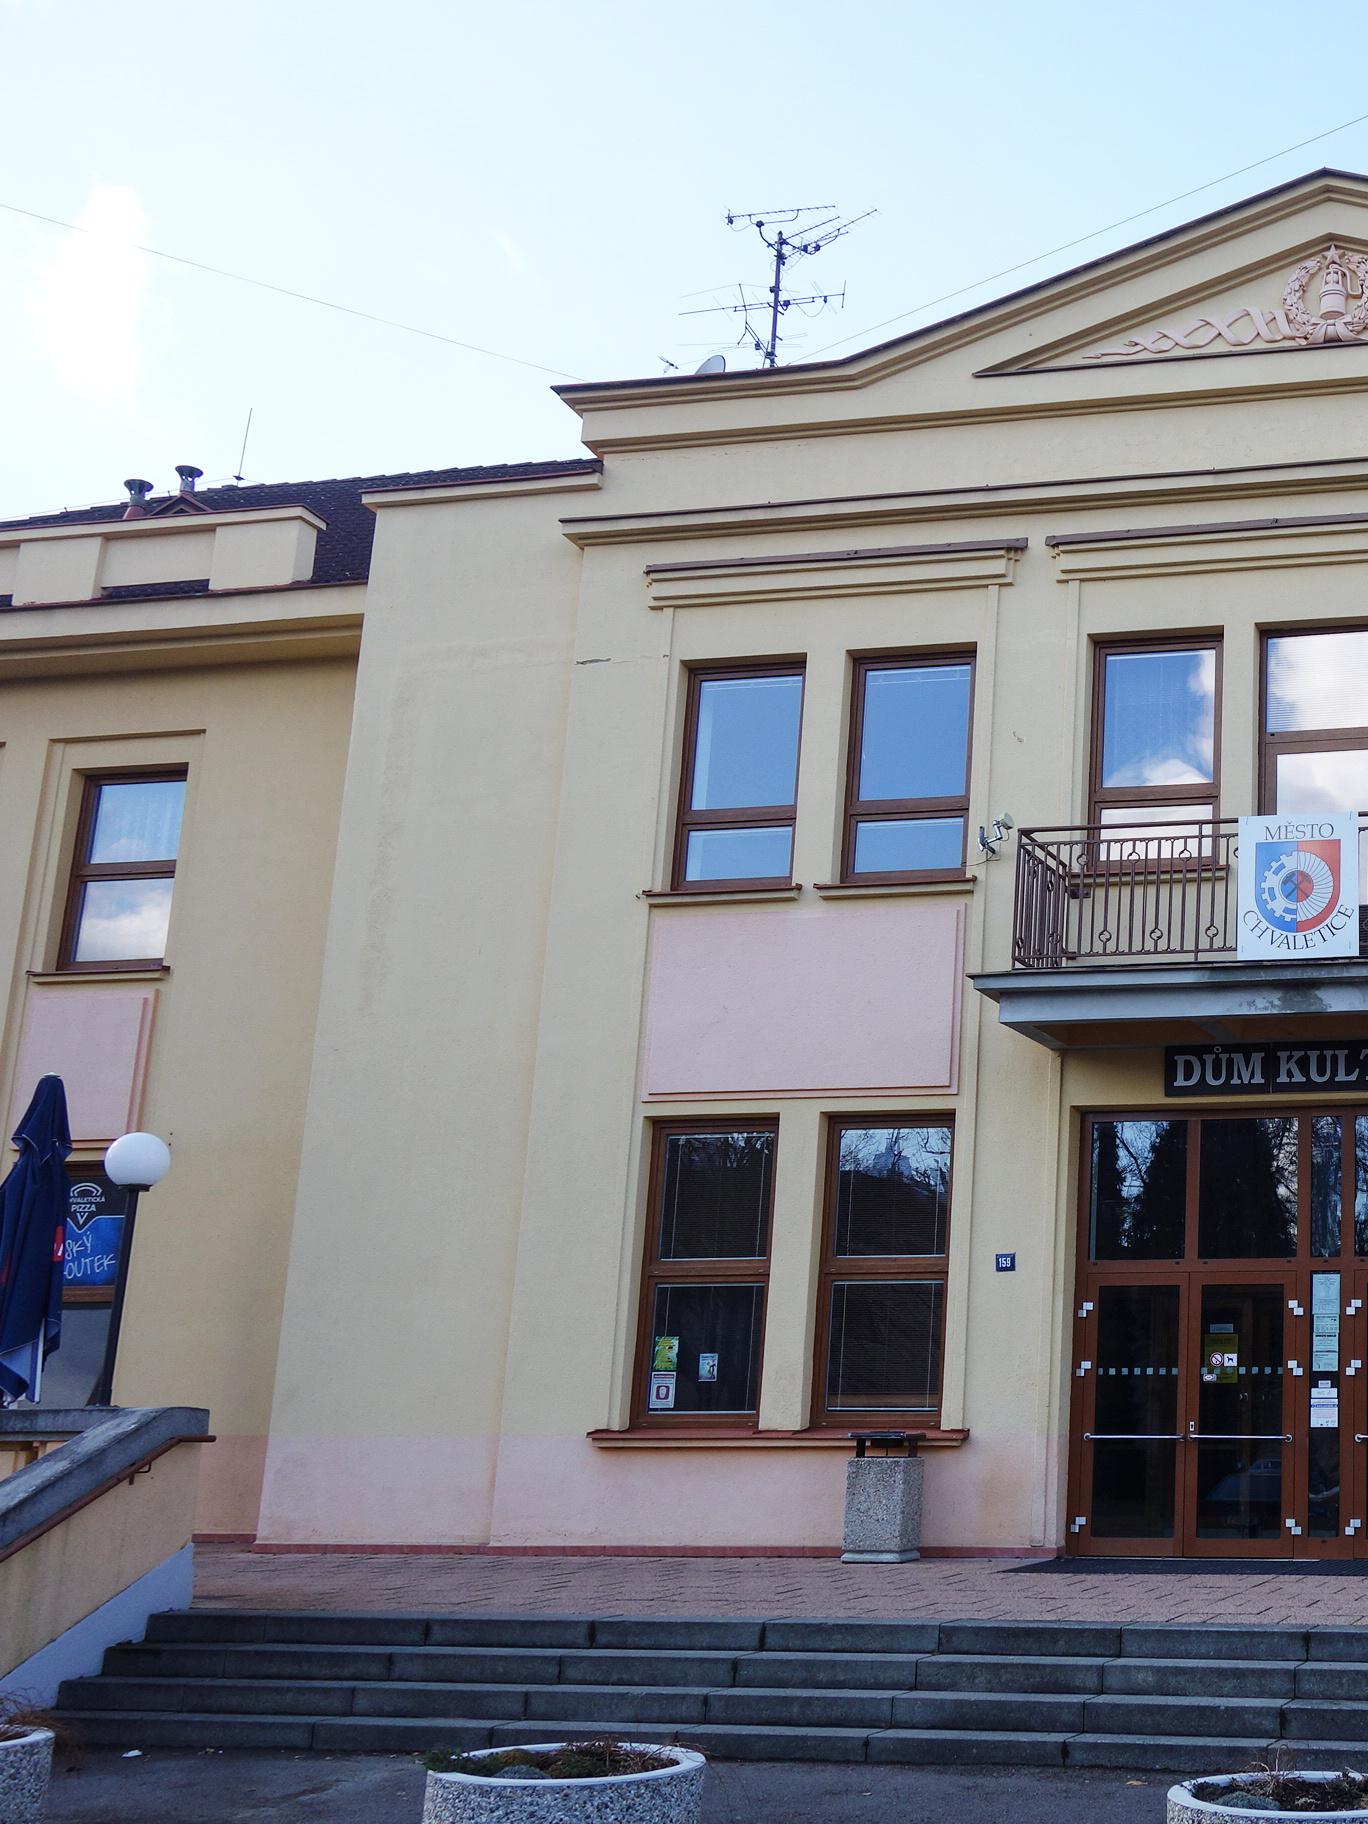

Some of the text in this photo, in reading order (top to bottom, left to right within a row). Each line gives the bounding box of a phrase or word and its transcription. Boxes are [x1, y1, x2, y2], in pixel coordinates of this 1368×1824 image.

[1264, 820, 1335, 841] MĚSTO
[1242, 903, 1355, 951] CHVALETICE
[1172, 1045, 1266, 1087] DŮM
[71, 1203, 97, 1212] PIZZA
[63, 1253, 116, 1280] OUTEK
[998, 1257, 1011, 1268] 159
